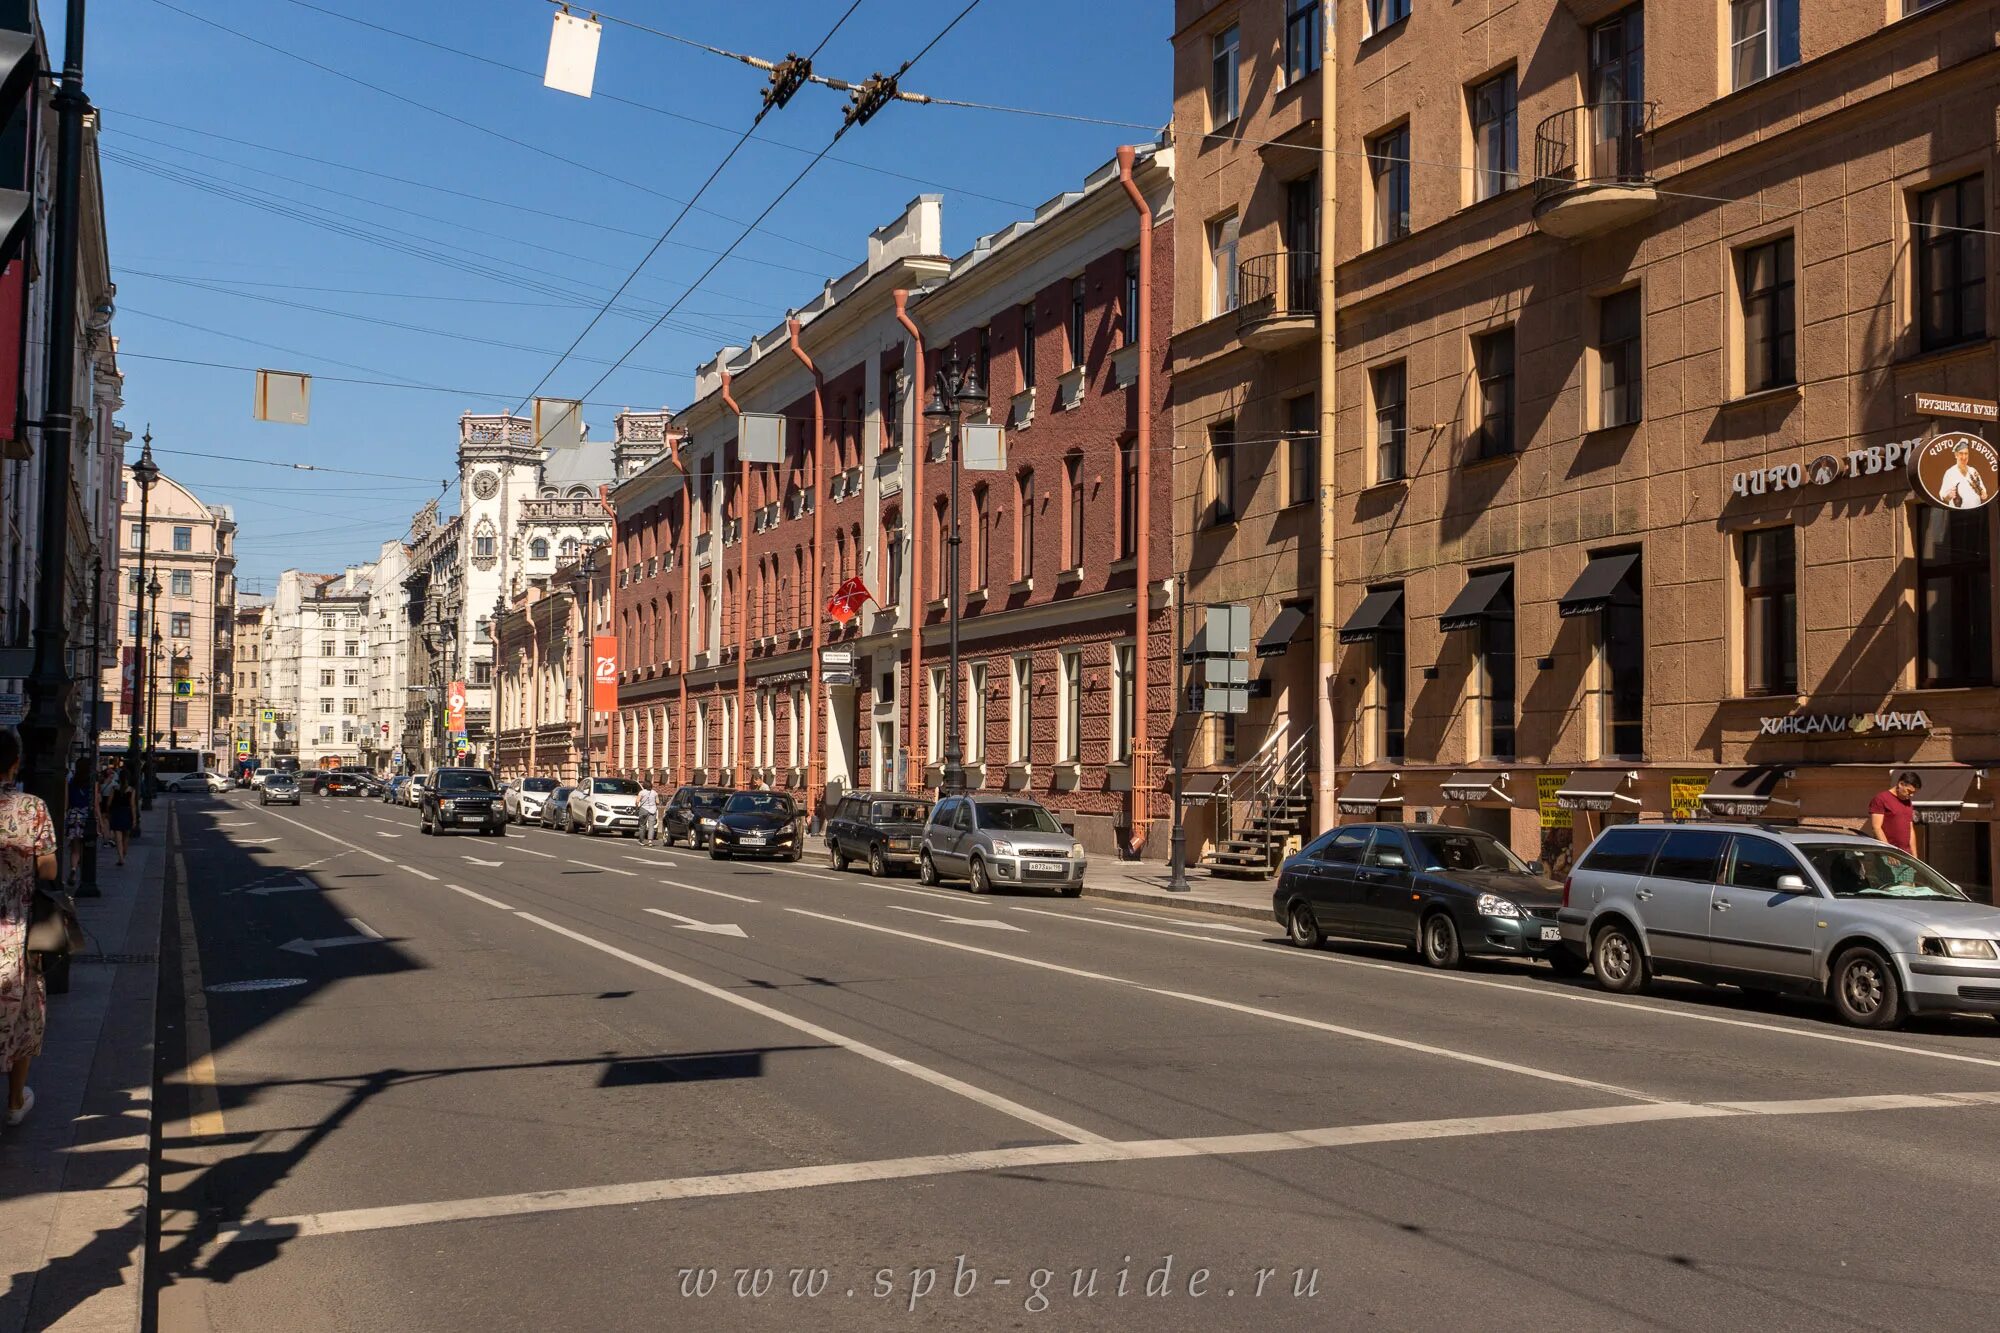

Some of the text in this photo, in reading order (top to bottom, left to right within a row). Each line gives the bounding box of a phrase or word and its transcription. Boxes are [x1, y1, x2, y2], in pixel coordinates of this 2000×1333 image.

[1919, 398, 1971, 413] ГРУЗИНСКАЯ
[1929, 439, 1954, 456] ЧИТО
[1733, 463, 1801, 497] ЧИТО
[596, 656, 616, 677] 75
[450, 695, 464, 713] 9
[1760, 710, 1929, 735] ХИНКАЛИ ЧАЧА
